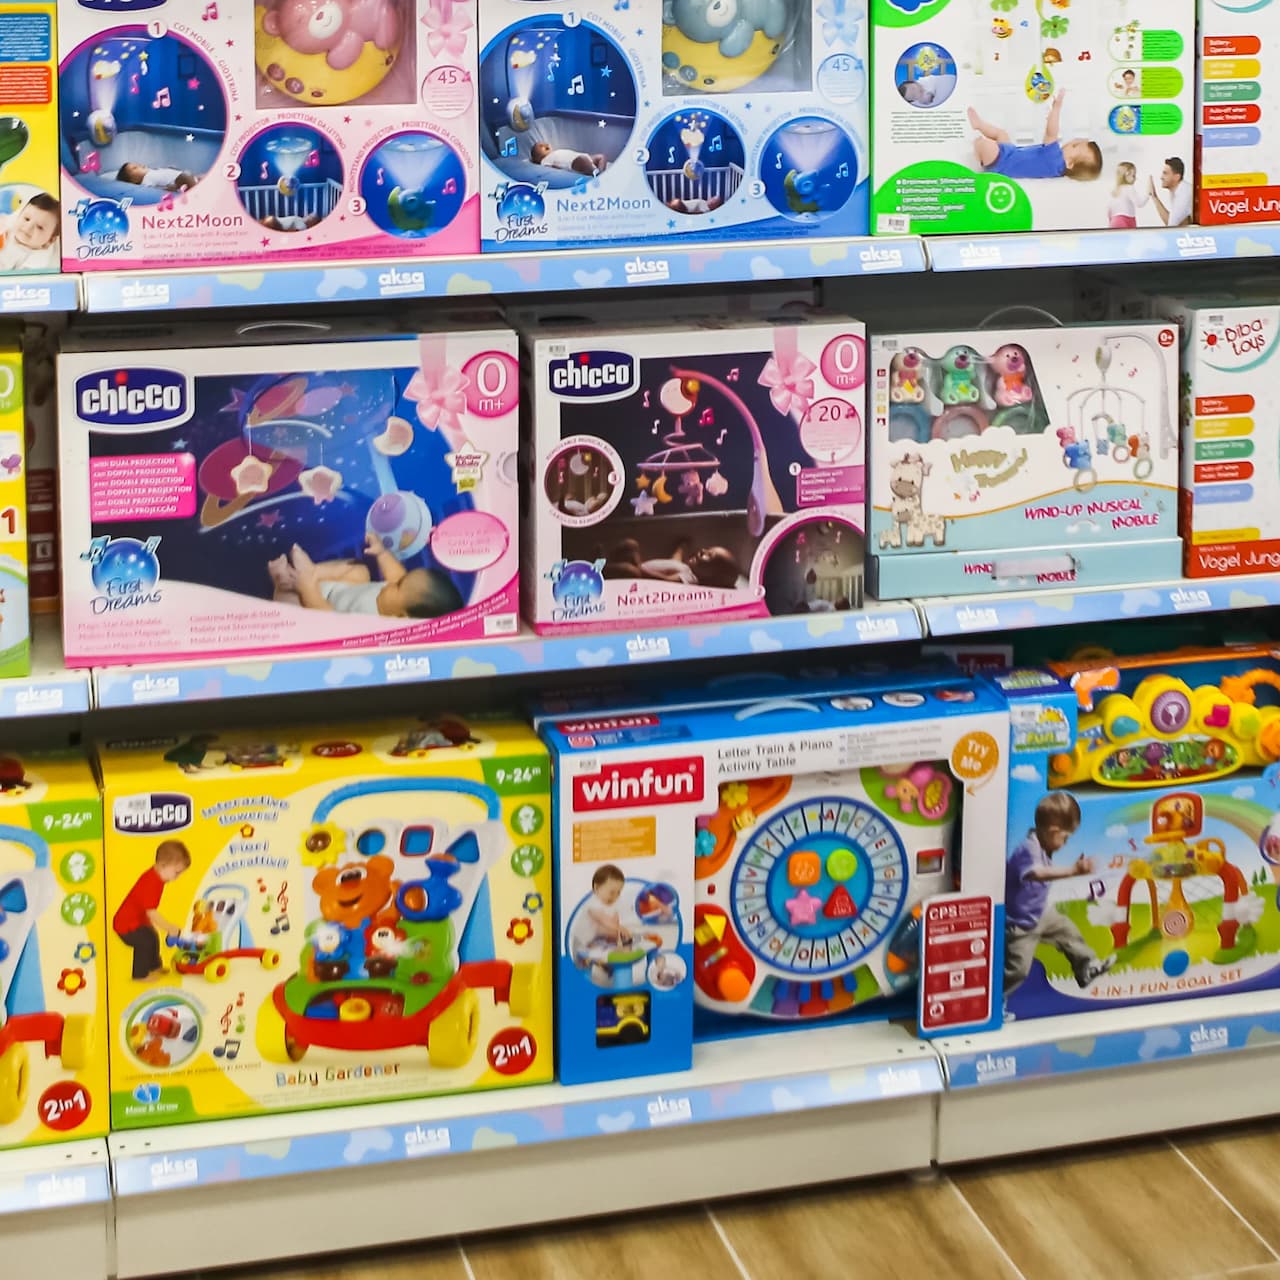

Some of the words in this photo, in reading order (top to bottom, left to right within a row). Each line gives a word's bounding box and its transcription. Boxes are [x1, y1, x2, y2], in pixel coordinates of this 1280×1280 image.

[557, 197, 651, 213] Next2Moon
[1208, 198, 1250, 217] Vogel
[142, 213, 243, 230] Next2Moon
[625, 257, 670, 273] aksa
[477, 357, 508, 396] 0
[553, 355, 629, 389] chicco
[81, 370, 182, 416] chicco
[479, 397, 506, 412] m+
[819, 405, 841, 421] 20
[1025, 505, 1083, 520] WIND-UP
[1088, 499, 1143, 515] MUSICAL
[1, 508, 16, 534] 1
[1112, 514, 1160, 530] MOBILE
[1199, 552, 1241, 571] Vogel
[106, 578, 144, 597] First
[90, 590, 162, 614] Dreams
[617, 591, 714, 607] Next2Dreams
[1170, 591, 1210, 604] aksa
[717, 746, 750, 760] Letter
[756, 743, 783, 757] Train
[787, 742, 797, 753] &
[800, 739, 833, 753] Piano
[718, 759, 762, 775] Activity
[765, 756, 797, 769] Table
[582, 769, 695, 803] winfun
[1090, 983, 1134, 999] 4-IN-1
[1220, 968, 1243, 982] SET
[44, 1090, 87, 1121] 2in1
[648, 1096, 689, 1113] aksa
